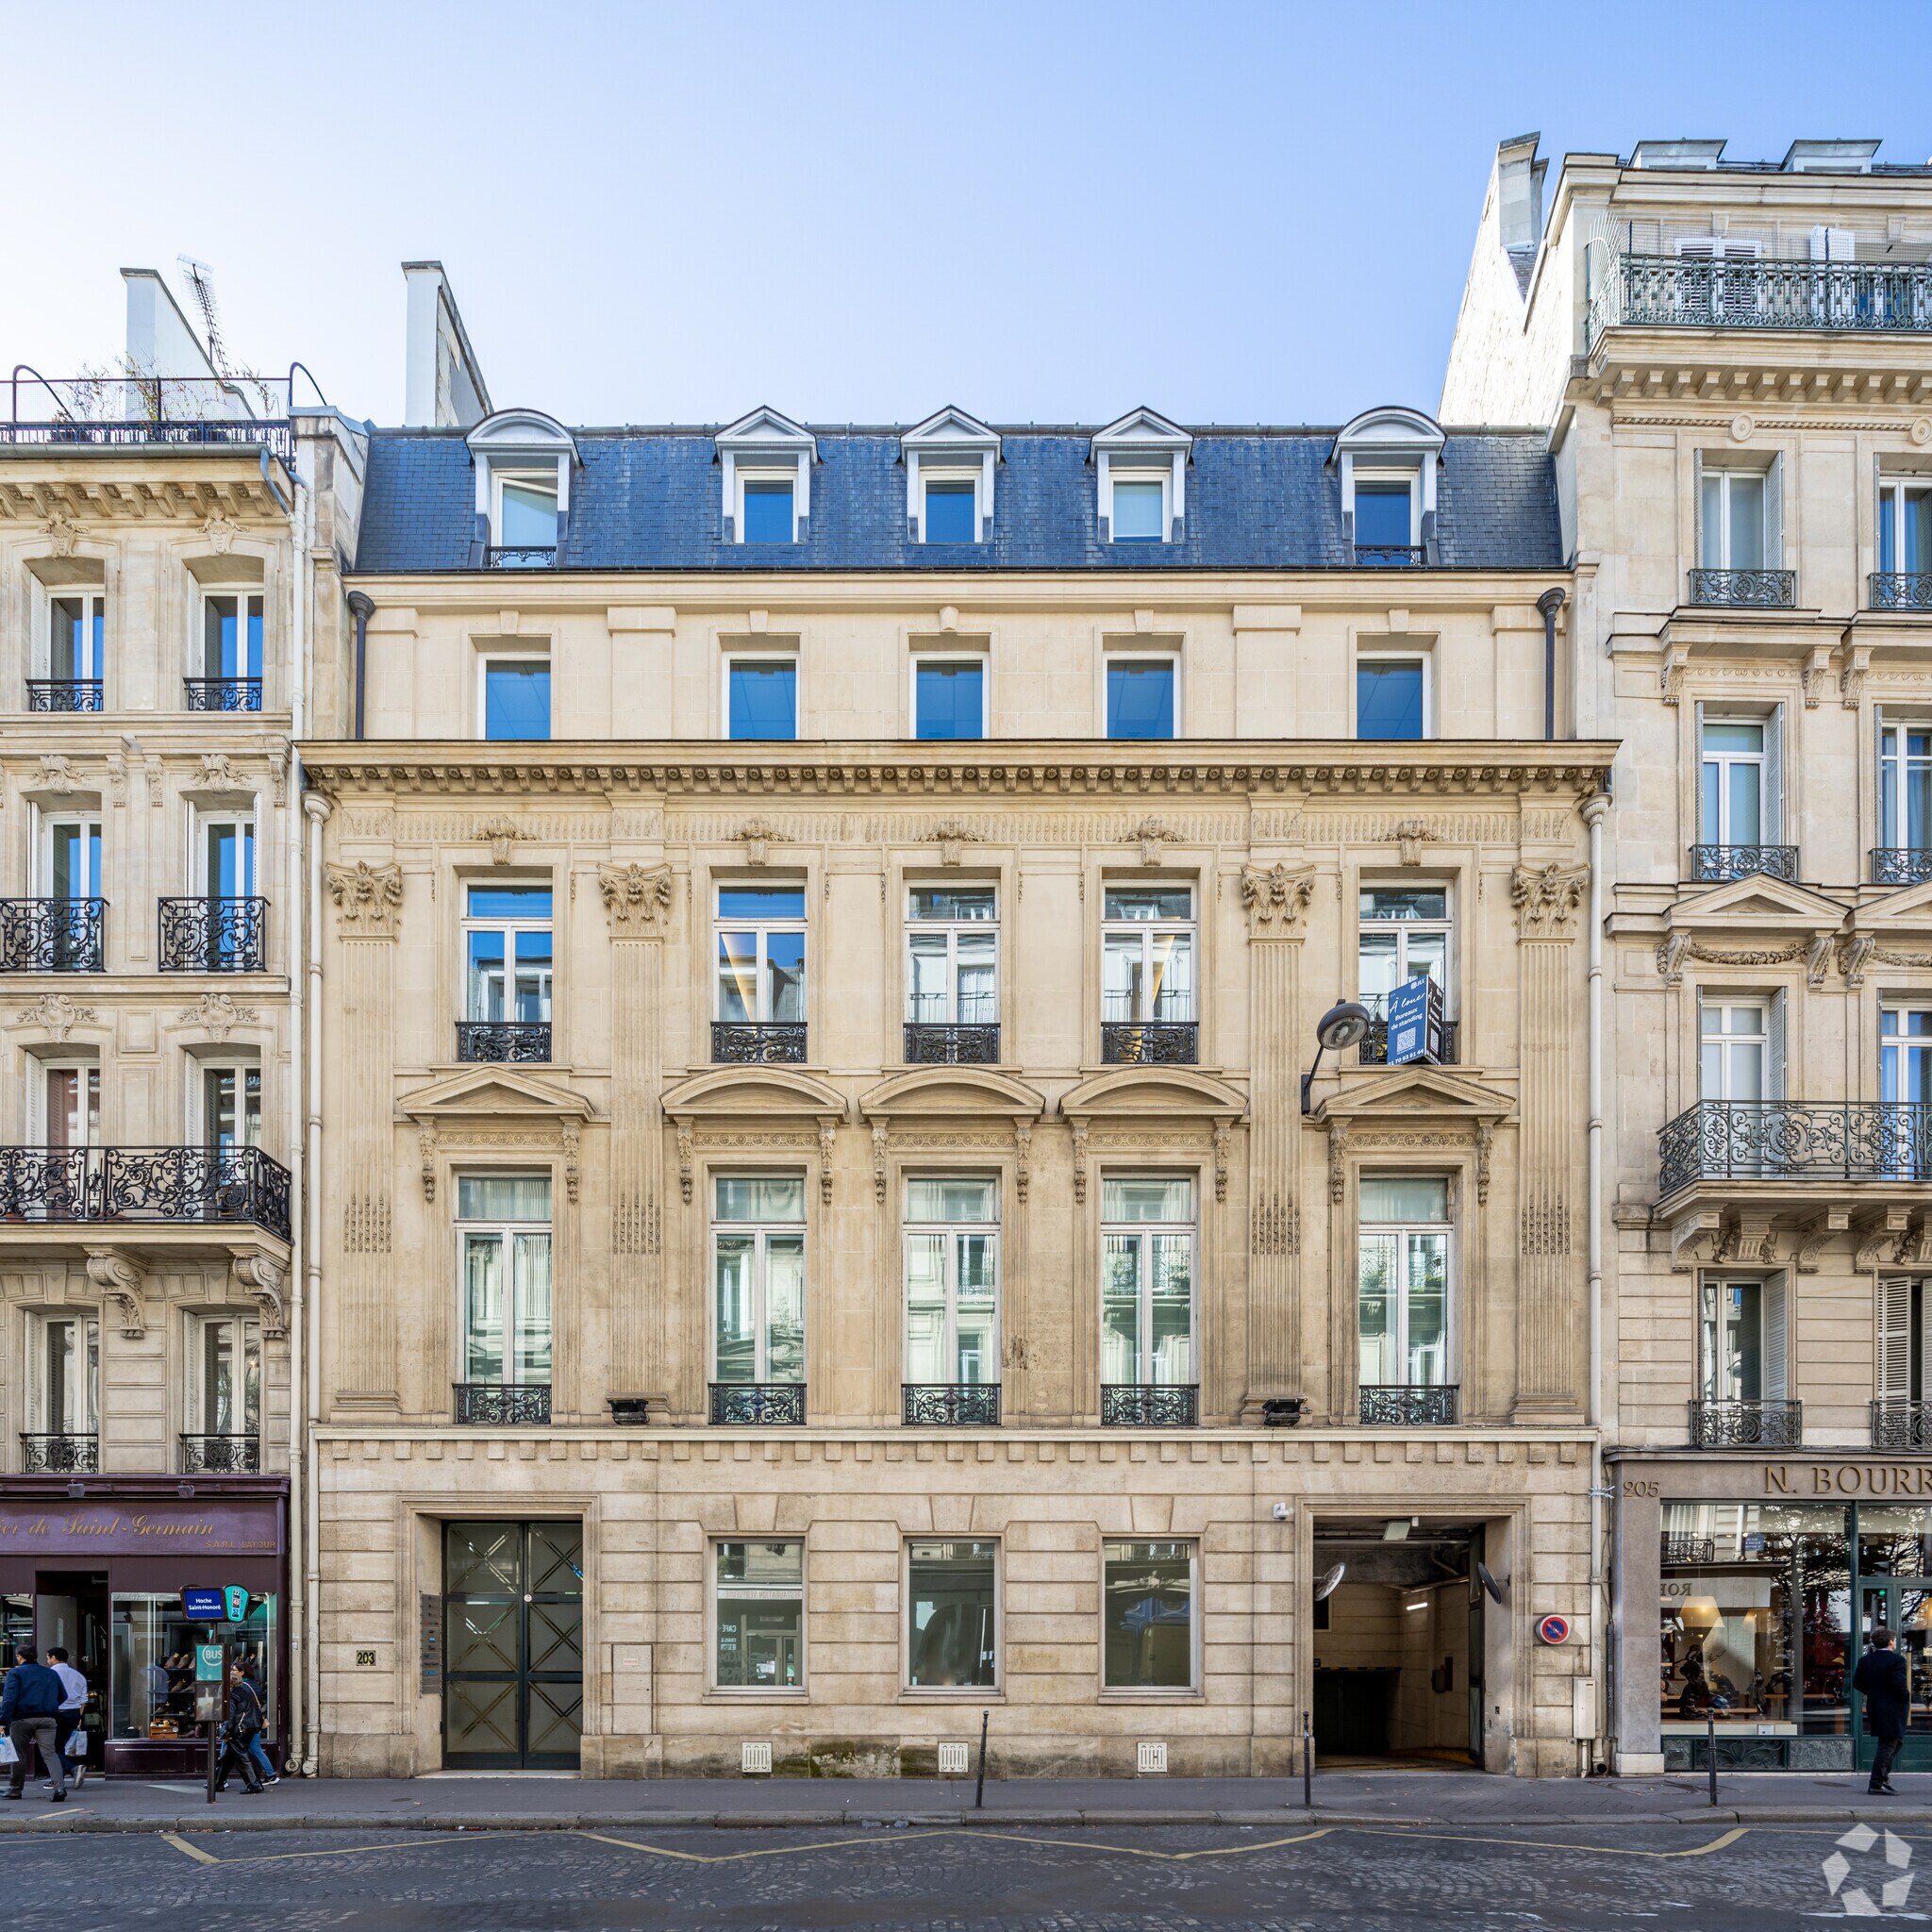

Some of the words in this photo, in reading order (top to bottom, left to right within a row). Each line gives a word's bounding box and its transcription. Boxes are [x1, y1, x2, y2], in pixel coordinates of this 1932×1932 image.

[1389, 997, 1398, 1014] À
[1401, 992, 1425, 1008] louer
[1395, 1008, 1418, 1021] Bureaux
[1399, 1013, 1423, 1027] standing
[1764, 1466, 1797, 1494] N.
[1623, 1480, 1660, 1498] 205
[28, 1518, 50, 1535] de
[205, 1650, 222, 1658] BUS
[357, 1652, 375, 1664] 203
